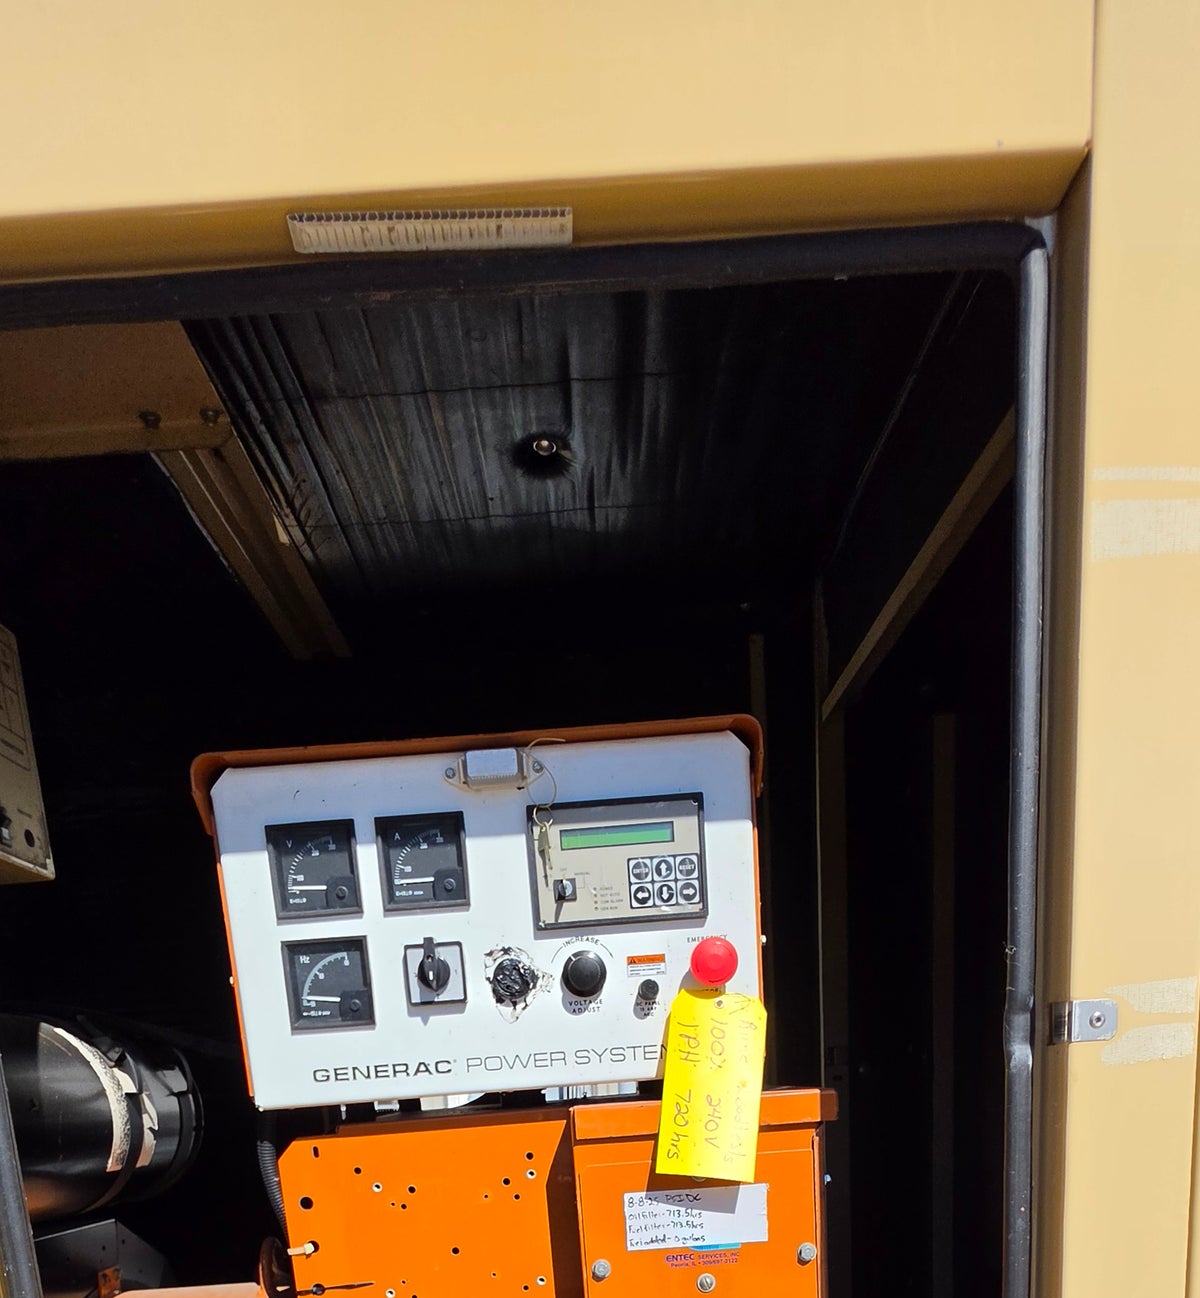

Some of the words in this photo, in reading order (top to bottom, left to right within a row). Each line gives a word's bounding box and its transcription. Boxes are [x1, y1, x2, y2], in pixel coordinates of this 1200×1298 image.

[394, 832, 401, 841] A
[286, 839, 293, 849] V
[562, 936, 600, 948] INCREASE
[300, 955, 311, 964] Hz
[568, 998, 604, 1007] VOLTAGE
[572, 1006, 601, 1014] ADJUST
[312, 1060, 453, 1083] GENERAC
[466, 1051, 567, 1073] POWER
[666, 1253, 695, 1262] ENTEC
